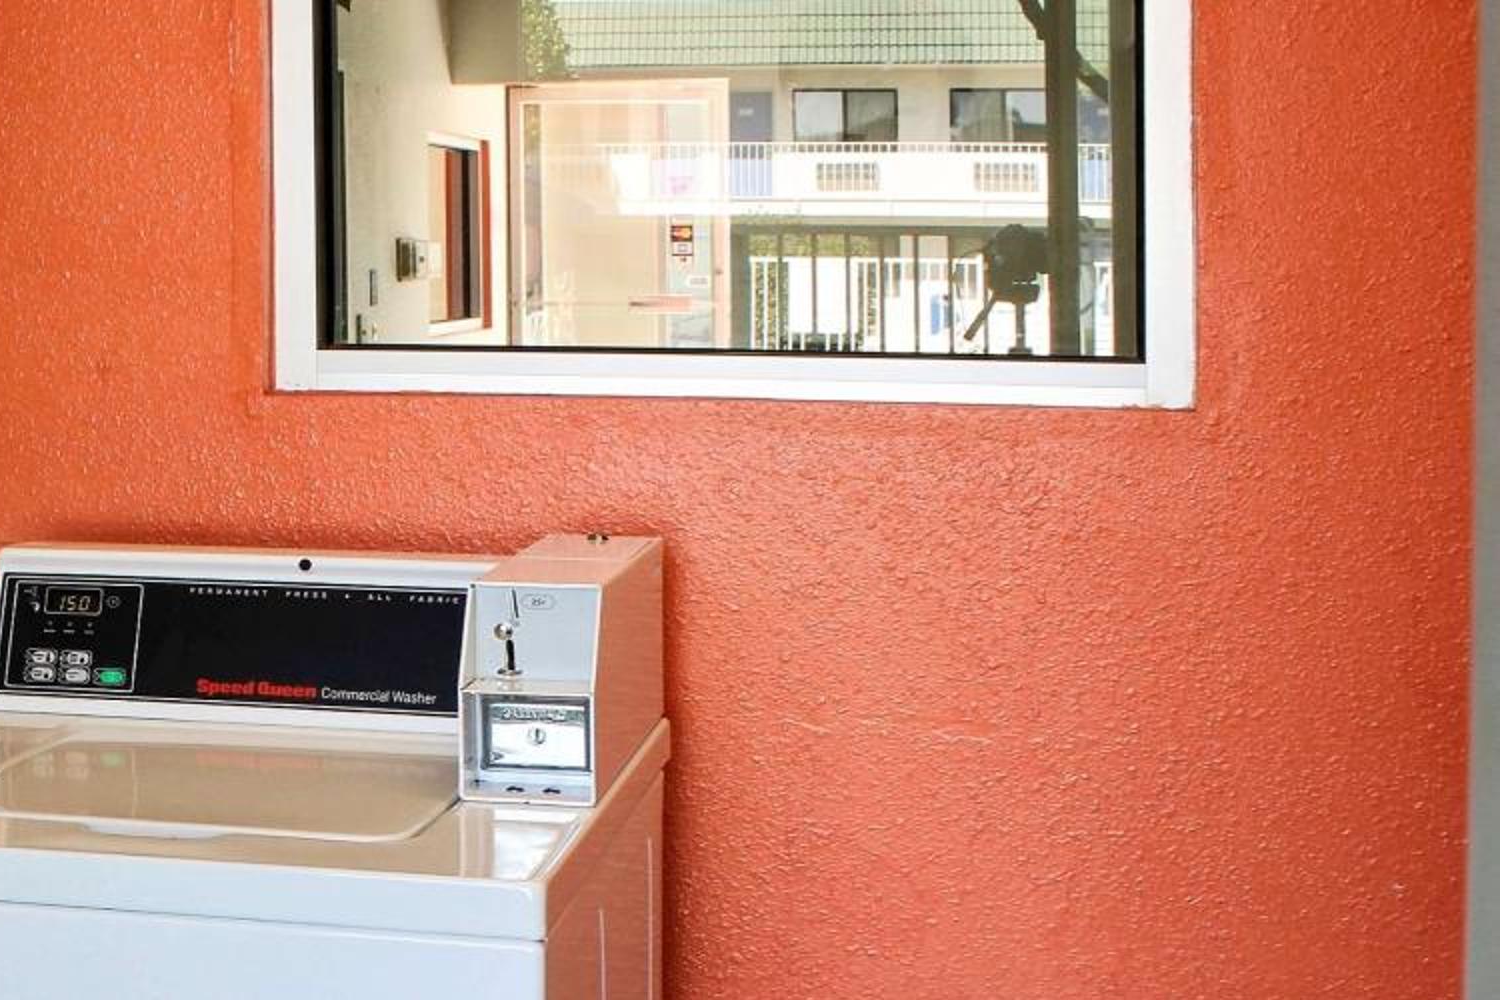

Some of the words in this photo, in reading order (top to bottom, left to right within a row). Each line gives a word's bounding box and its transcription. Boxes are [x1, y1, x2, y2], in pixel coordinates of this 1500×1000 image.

[189, 586, 269, 598] PERMANENT
[285, 590, 329, 600] PRESS
[59, 594, 91, 612] 150
[195, 677, 254, 697] Speed
[257, 680, 317, 699] Queen
[320, 685, 390, 703] Commercial
[392, 690, 437, 705] Washer
